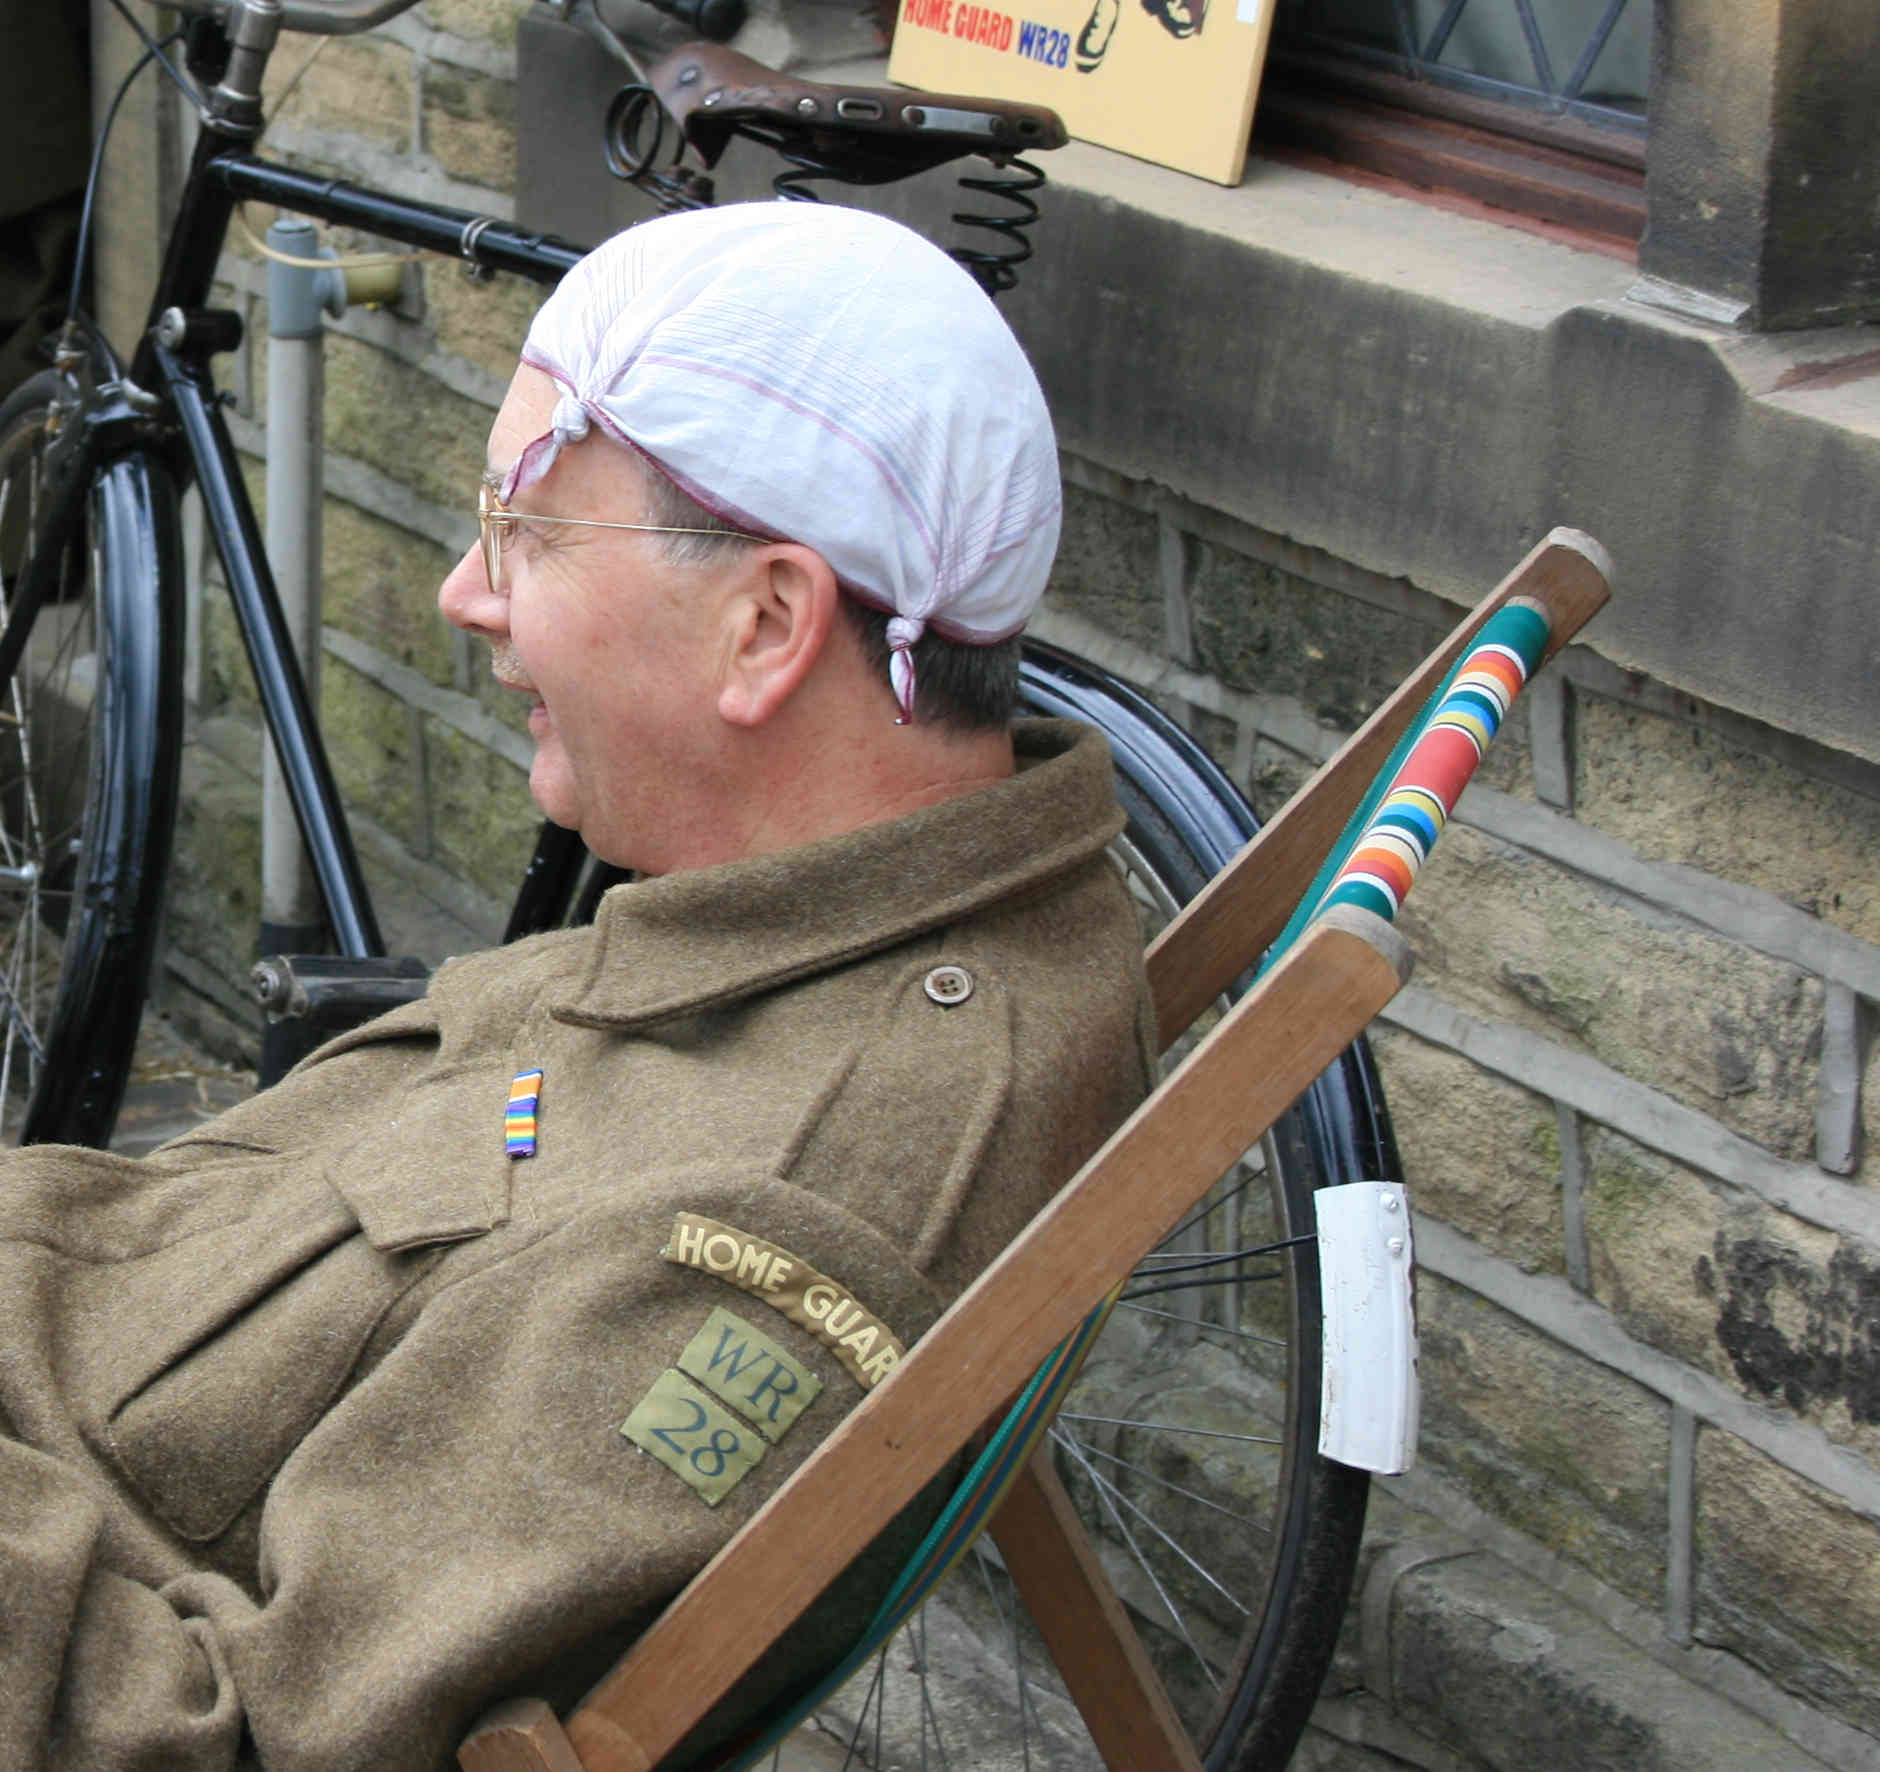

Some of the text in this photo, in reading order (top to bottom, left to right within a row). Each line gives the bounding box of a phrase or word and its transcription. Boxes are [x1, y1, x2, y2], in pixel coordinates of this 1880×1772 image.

[903, 0, 1070, 69] HOME GUARD WR28
[677, 1224, 901, 1385] HOME GUAR
[703, 1326, 800, 1424] WR
[650, 1398, 741, 1478] 28
